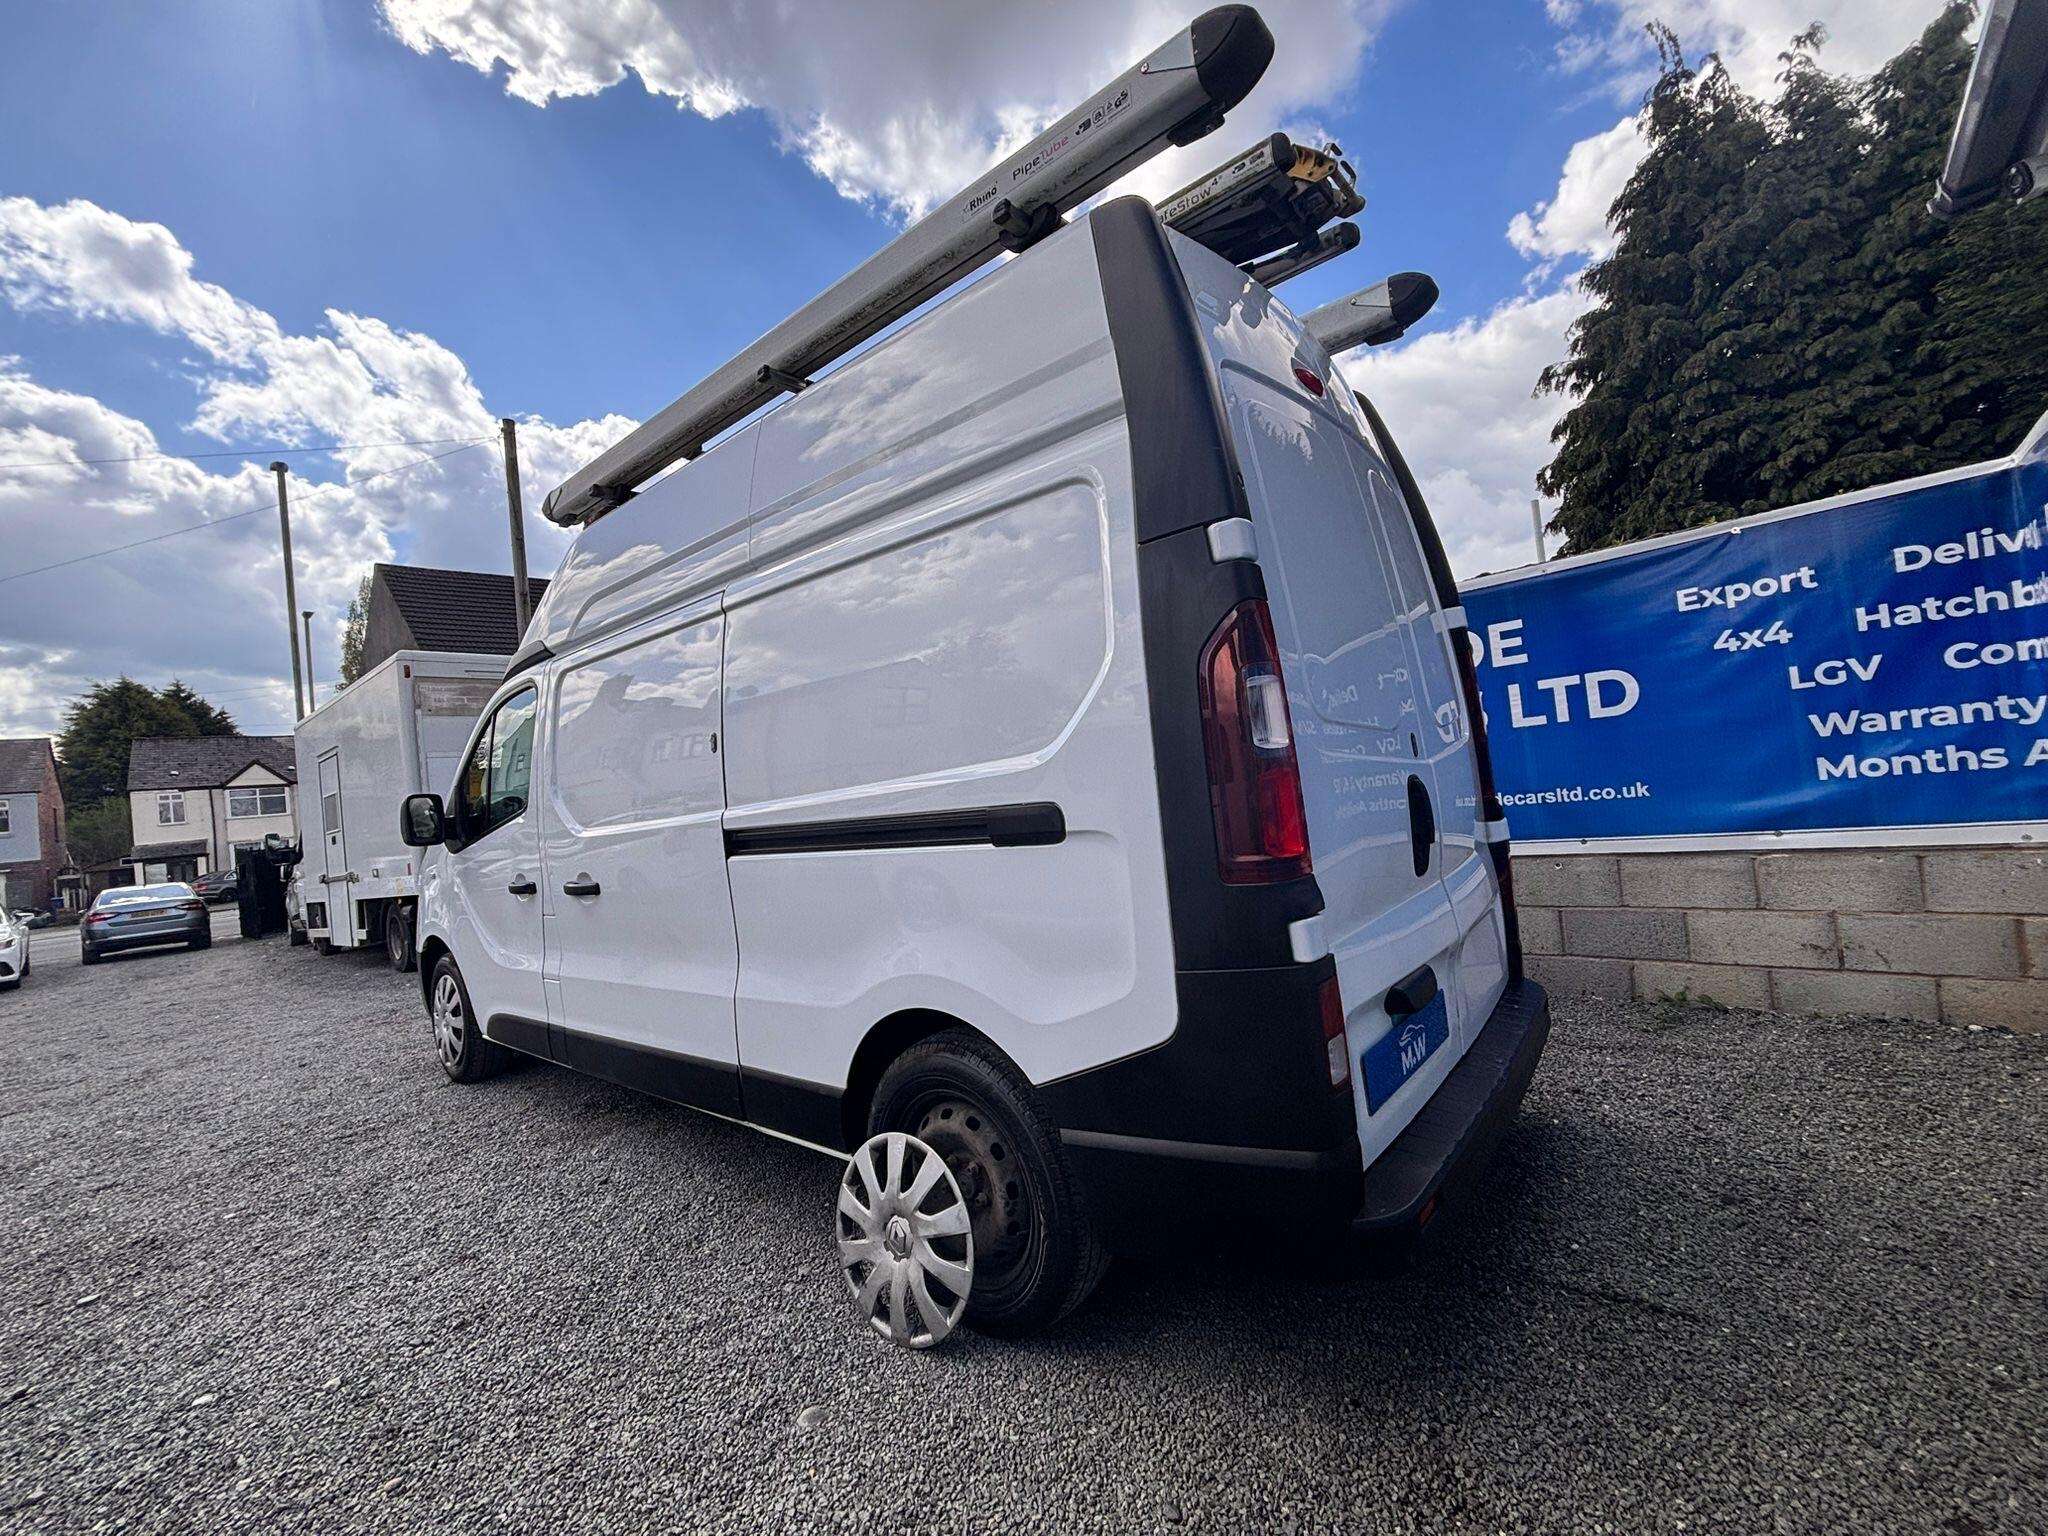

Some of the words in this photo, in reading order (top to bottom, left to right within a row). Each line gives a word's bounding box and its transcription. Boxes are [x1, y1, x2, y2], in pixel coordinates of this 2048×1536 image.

[969, 186, 998, 211] Rhino
[1012, 136, 1070, 181] PipeTube
[1676, 566, 1819, 612] Export
[1713, 620, 1794, 652] 4x4
[1788, 654, 1883, 690] LGV
[1507, 669, 1641, 729] LTD
[1808, 694, 2047, 738] Warranty
[1816, 744, 2009, 781] Months
